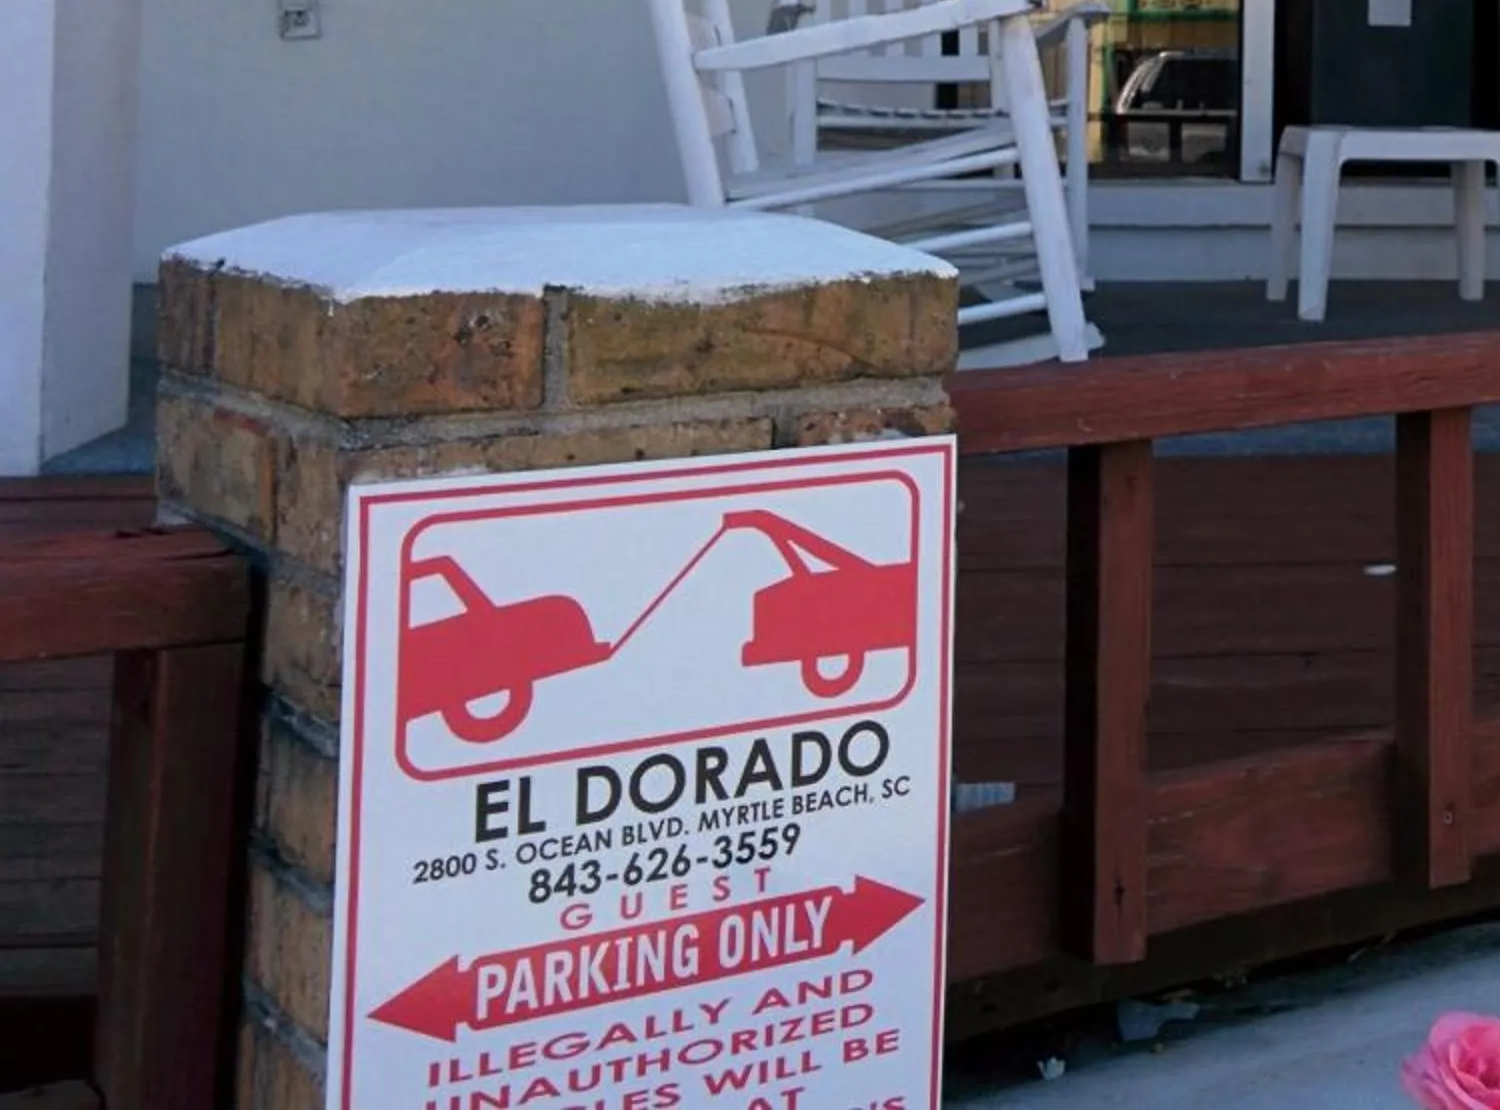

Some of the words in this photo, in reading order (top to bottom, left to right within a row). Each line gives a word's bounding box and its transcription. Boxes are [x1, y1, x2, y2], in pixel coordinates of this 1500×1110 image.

[412, 852, 478, 884] 2800
[484, 848, 507, 871] S.
[515, 828, 613, 865] OCEAN
[621, 816, 690, 848] BLVD.
[697, 797, 785, 833] MYRTLE
[791, 782, 875, 815] BEACH,
[881, 775, 912, 799] SC
[475, 776, 547, 843] EL
[575, 719, 890, 827] DORADO
[527, 822, 801, 904] 843-626-3559
[559, 866, 772, 931] GUEST
[474, 922, 700, 1023] PARKING
[717, 895, 834, 970] ONLY
[427, 996, 732, 1088] ILLEGALLY
[751, 968, 875, 1016] AND
[703, 1049, 823, 1097] WILL
[842, 1028, 900, 1064] BE
